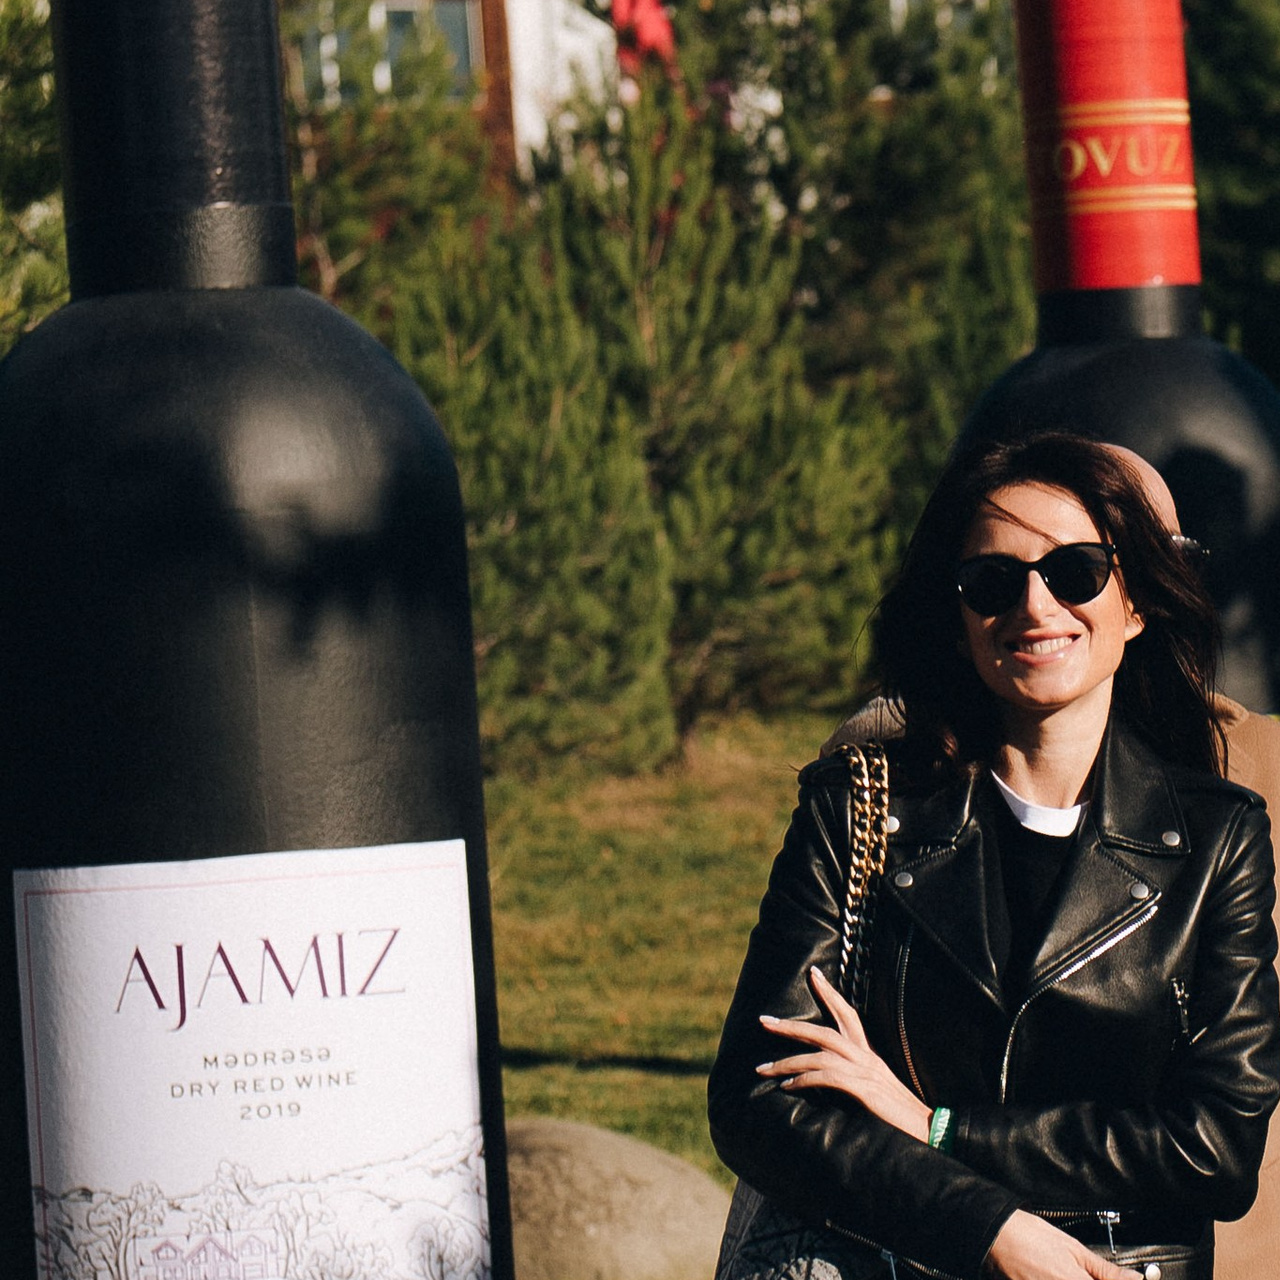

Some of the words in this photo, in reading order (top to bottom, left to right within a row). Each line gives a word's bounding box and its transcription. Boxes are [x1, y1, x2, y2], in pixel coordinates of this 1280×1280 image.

[1034, 133, 1185, 180] OVUZ
[116, 927, 406, 1032] AJAMIZ
[170, 1081, 220, 1099] DRY
[234, 1077, 285, 1094] RED
[295, 1071, 357, 1090] WINE
[240, 1102, 302, 1120] 2019
